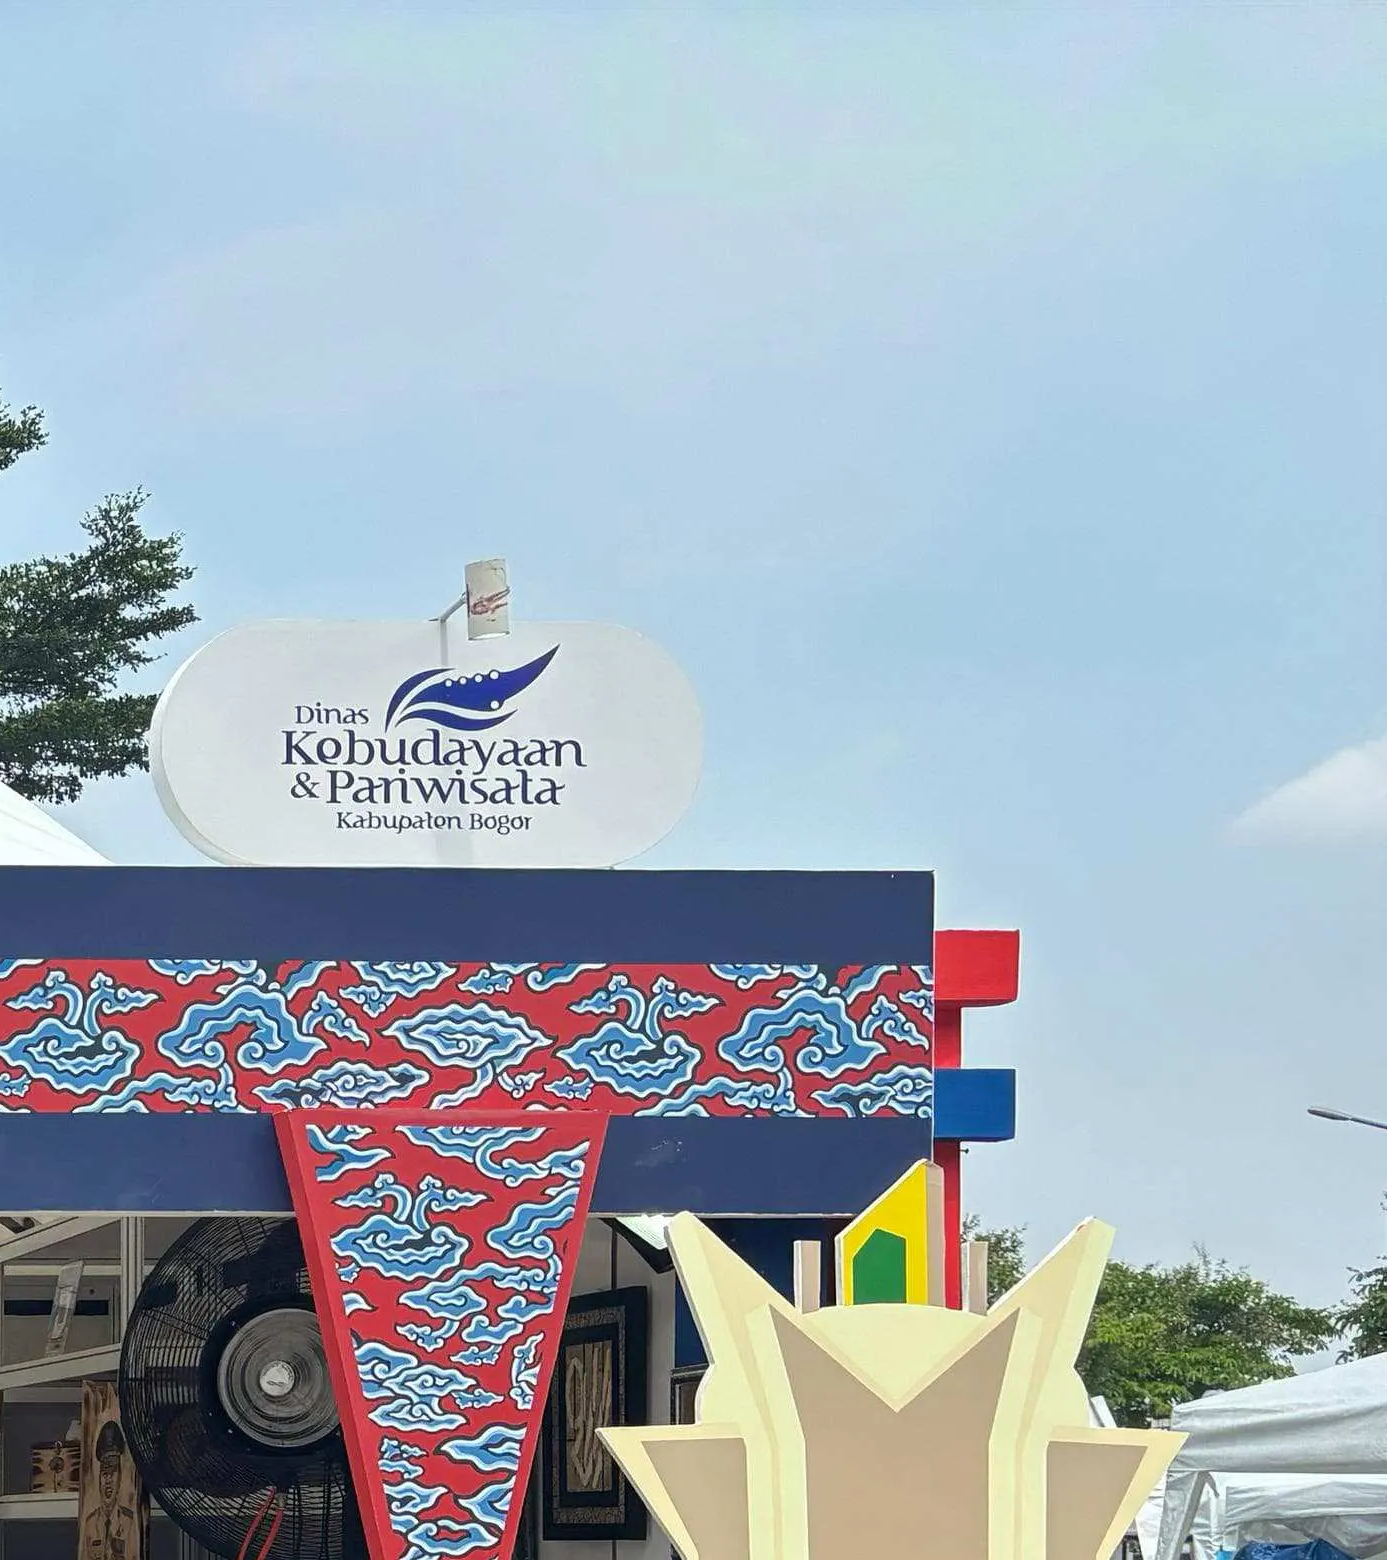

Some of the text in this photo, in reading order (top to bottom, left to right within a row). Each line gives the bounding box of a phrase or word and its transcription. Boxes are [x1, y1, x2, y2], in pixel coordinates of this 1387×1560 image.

[294, 702, 369, 725] Dinas
[280, 729, 588, 775] Kebudayaan
[290, 768, 566, 805] & Pariwisata
[336, 811, 533, 835] Kabupaten Bogor
